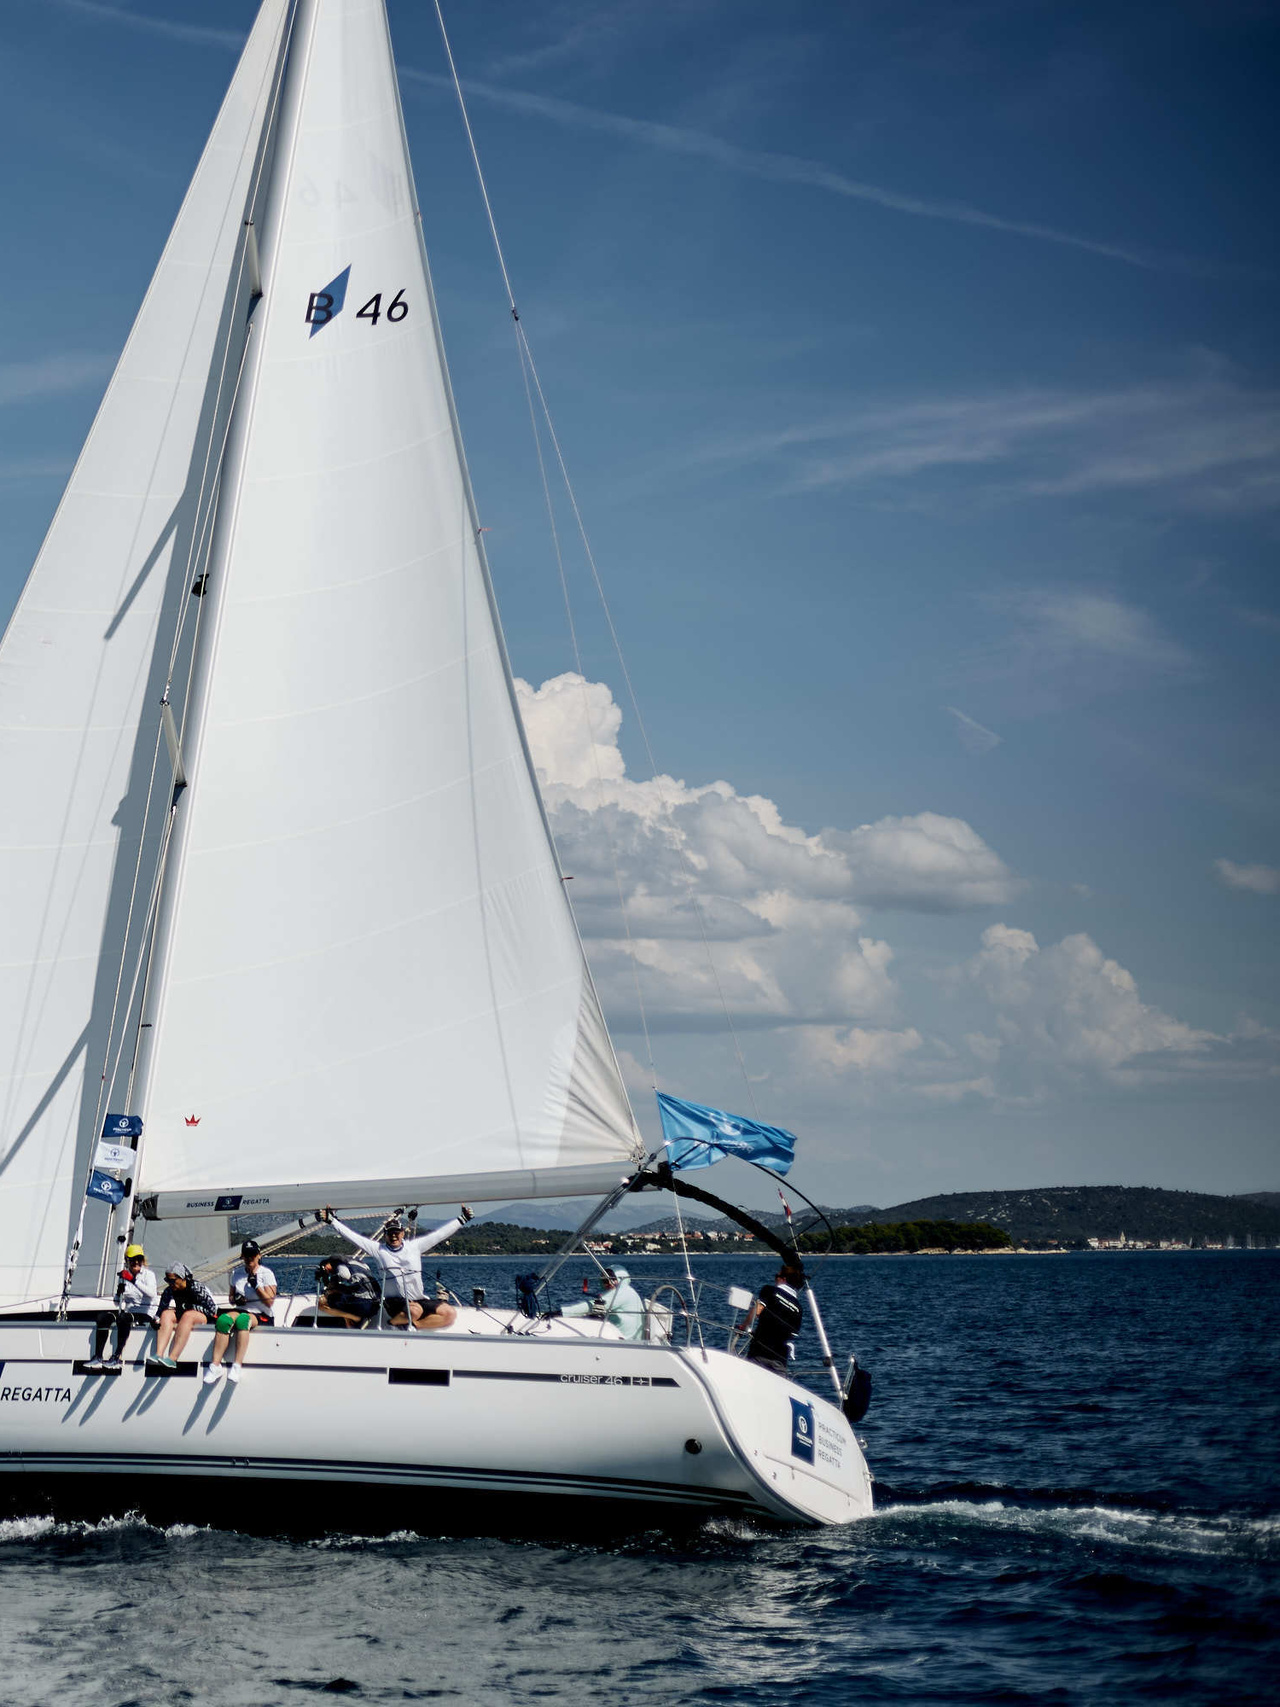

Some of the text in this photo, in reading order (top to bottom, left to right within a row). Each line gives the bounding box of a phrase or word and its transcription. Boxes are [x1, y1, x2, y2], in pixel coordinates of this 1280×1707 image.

[305, 288, 409, 325] B 46
[560, 1374, 623, 1385] cruiser 46
[0, 1387, 71, 1402] REGATTA
